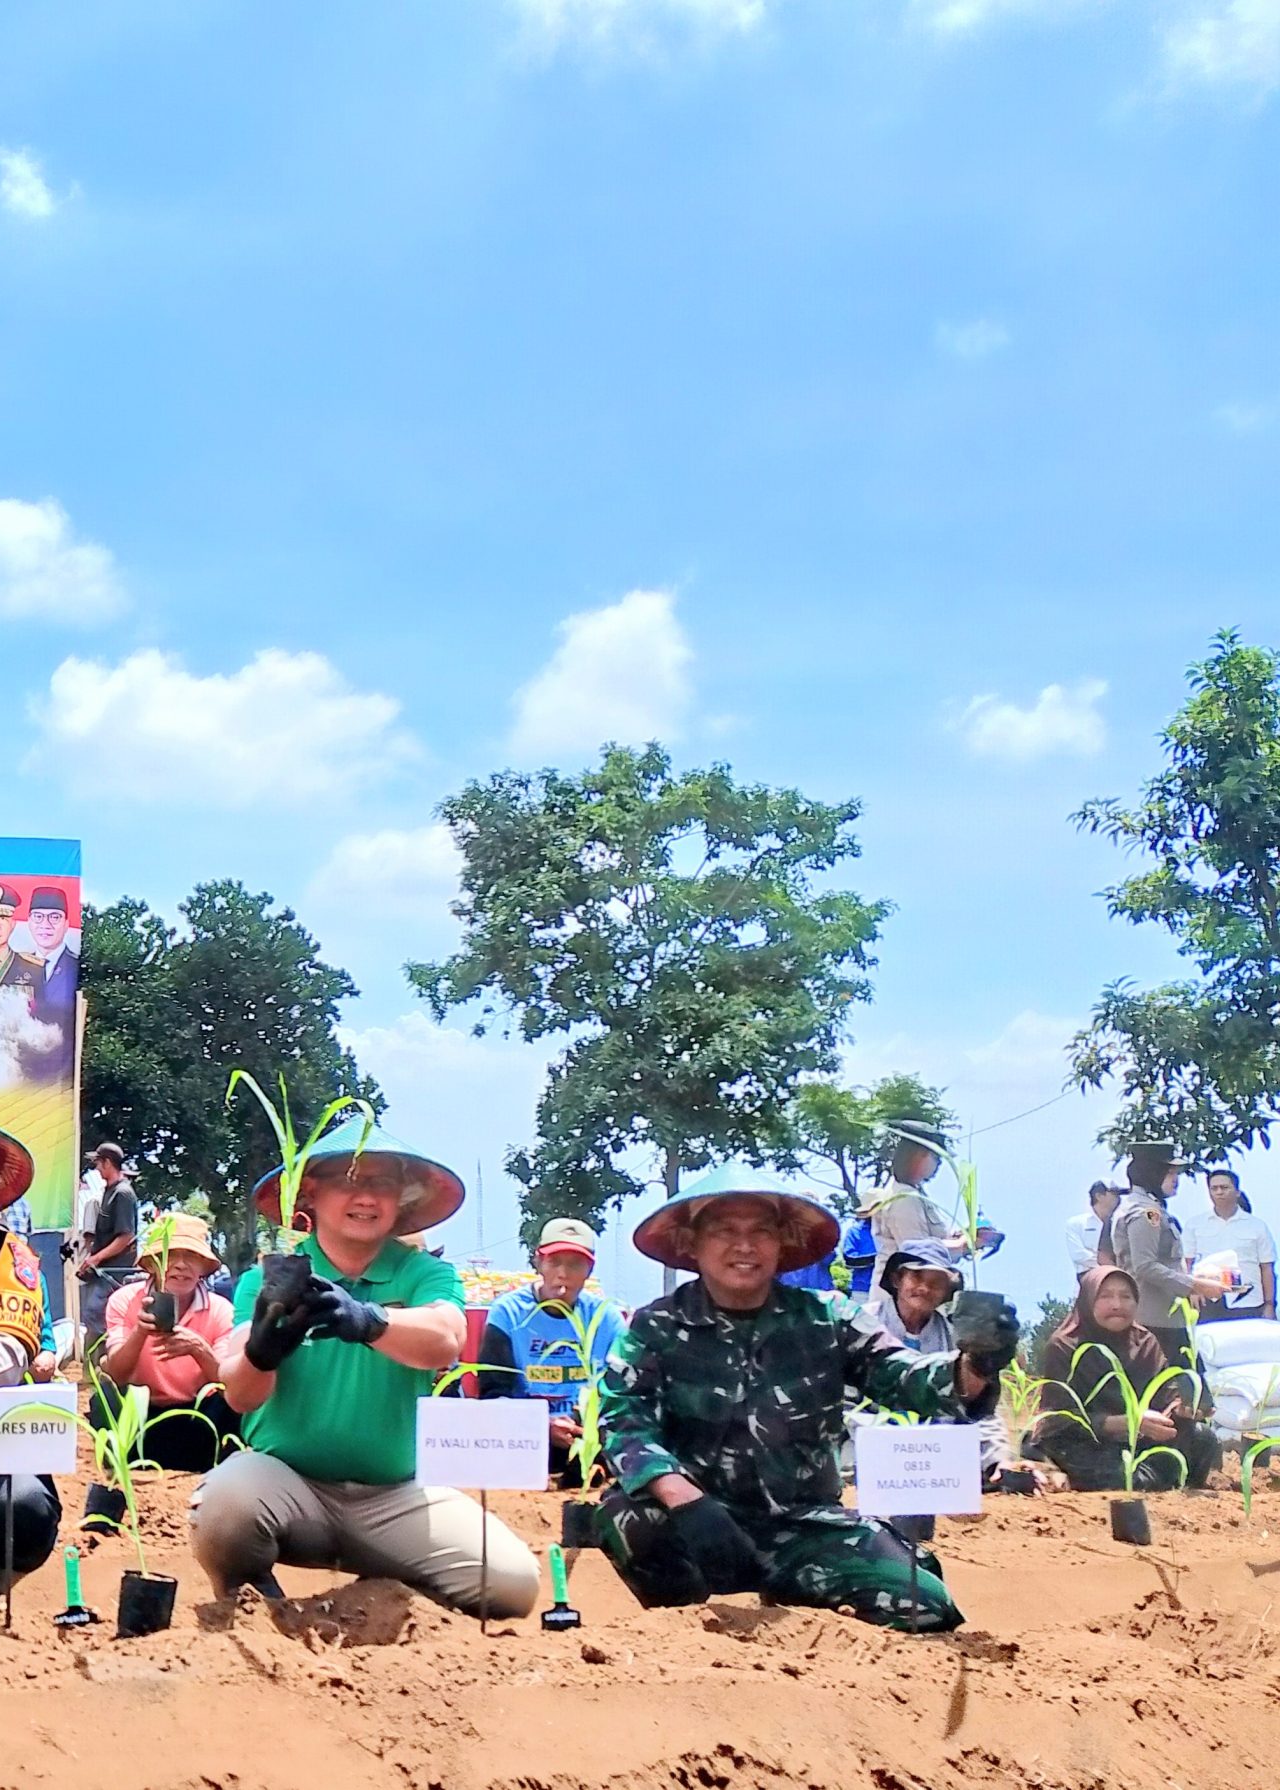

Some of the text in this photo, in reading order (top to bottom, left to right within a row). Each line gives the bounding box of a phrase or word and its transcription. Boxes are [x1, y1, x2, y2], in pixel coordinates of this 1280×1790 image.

[30, 1421, 67, 1435] BATU
[440, 1437, 470, 1449] WALI
[473, 1438, 505, 1449] KOTA
[508, 1438, 540, 1450] BATU
[893, 1442, 942, 1454] PABUNG
[903, 1461, 932, 1472] 0818
[876, 1477, 961, 1490] MALANG-BATU
